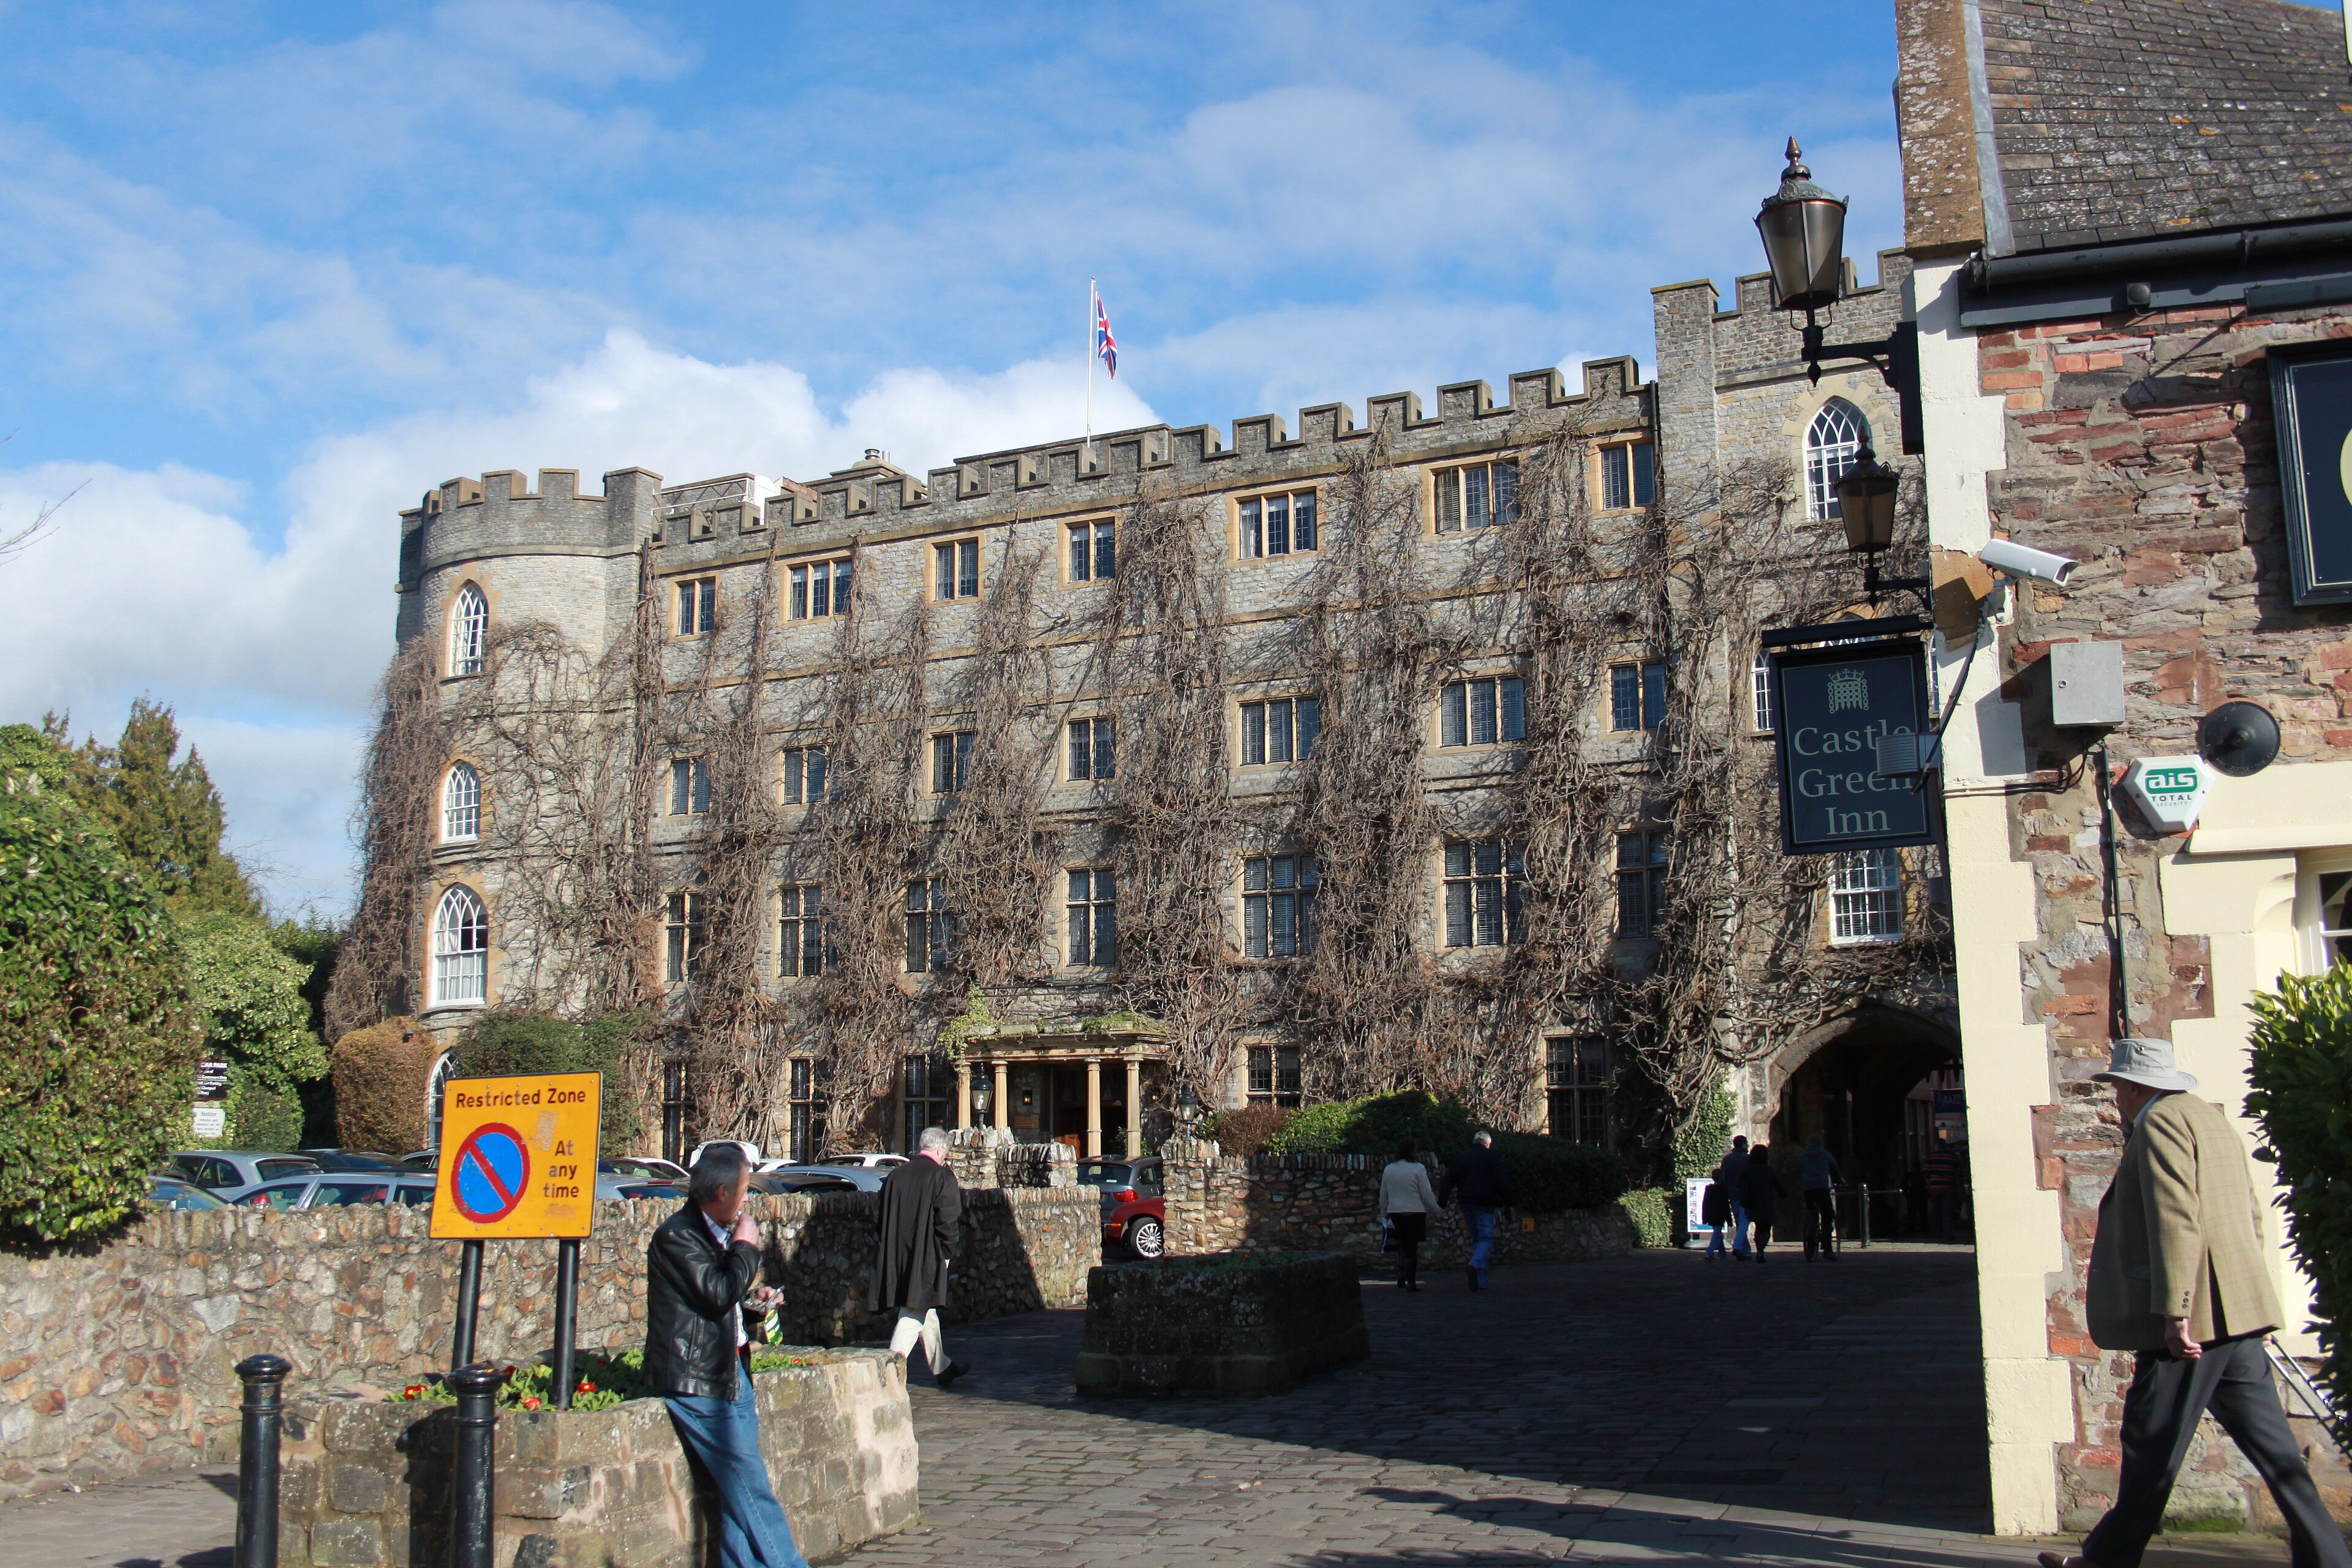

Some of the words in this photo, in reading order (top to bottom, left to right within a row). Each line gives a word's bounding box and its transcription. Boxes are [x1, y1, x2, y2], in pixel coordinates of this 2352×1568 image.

[1825, 807, 1891, 835] Inn
[456, 1089, 540, 1109] Restricted
[547, 1088, 586, 1104] Zone
[554, 1140, 573, 1156] At
[549, 1164, 578, 1180] any
[543, 1183, 579, 1198] time
